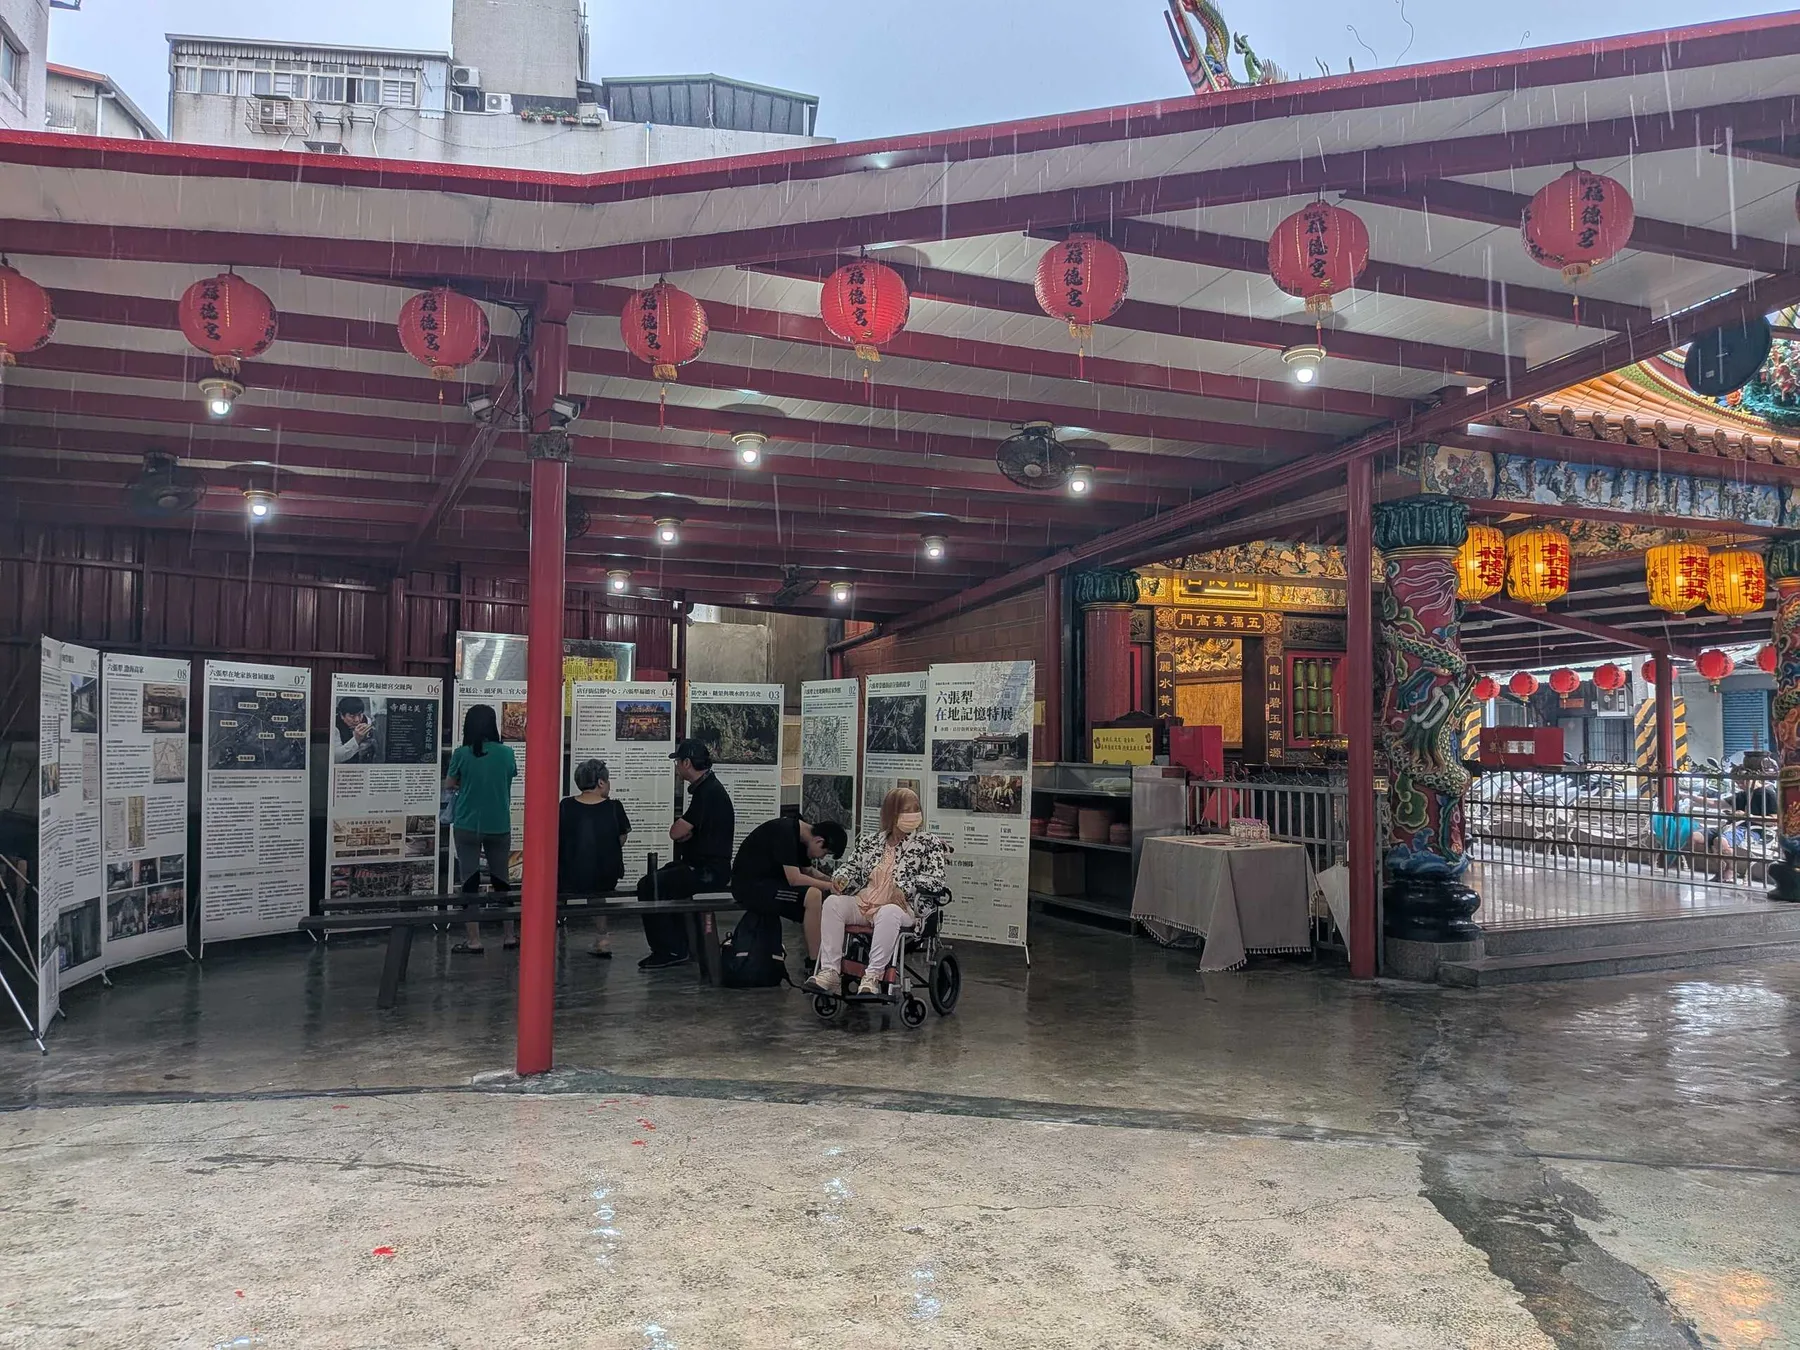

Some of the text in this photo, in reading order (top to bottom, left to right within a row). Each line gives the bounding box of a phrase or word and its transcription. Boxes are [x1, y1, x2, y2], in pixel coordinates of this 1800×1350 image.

[1577, 186, 1605, 249] 福德宮
[1305, 220, 1328, 279] 福德宮
[1063, 249, 1084, 308] 福德宮
[847, 271, 868, 327] 福德宮
[200, 285, 221, 341] 福德宮
[419, 299, 440, 352] 福德宮
[640, 297, 662, 350] 福德宮
[1476, 546, 1504, 587] 福德宮
[177, 668, 187, 680] 08
[294, 675, 306, 685] 07
[427, 684, 440, 695] 06
[848, 685, 856, 695] 02
[919, 678, 927, 690] 01
[661, 687, 674, 698] 04
[768, 690, 780, 701] 03
[935, 690, 973, 705] 六張犁
[935, 706, 1013, 722] 在地記憶特展
